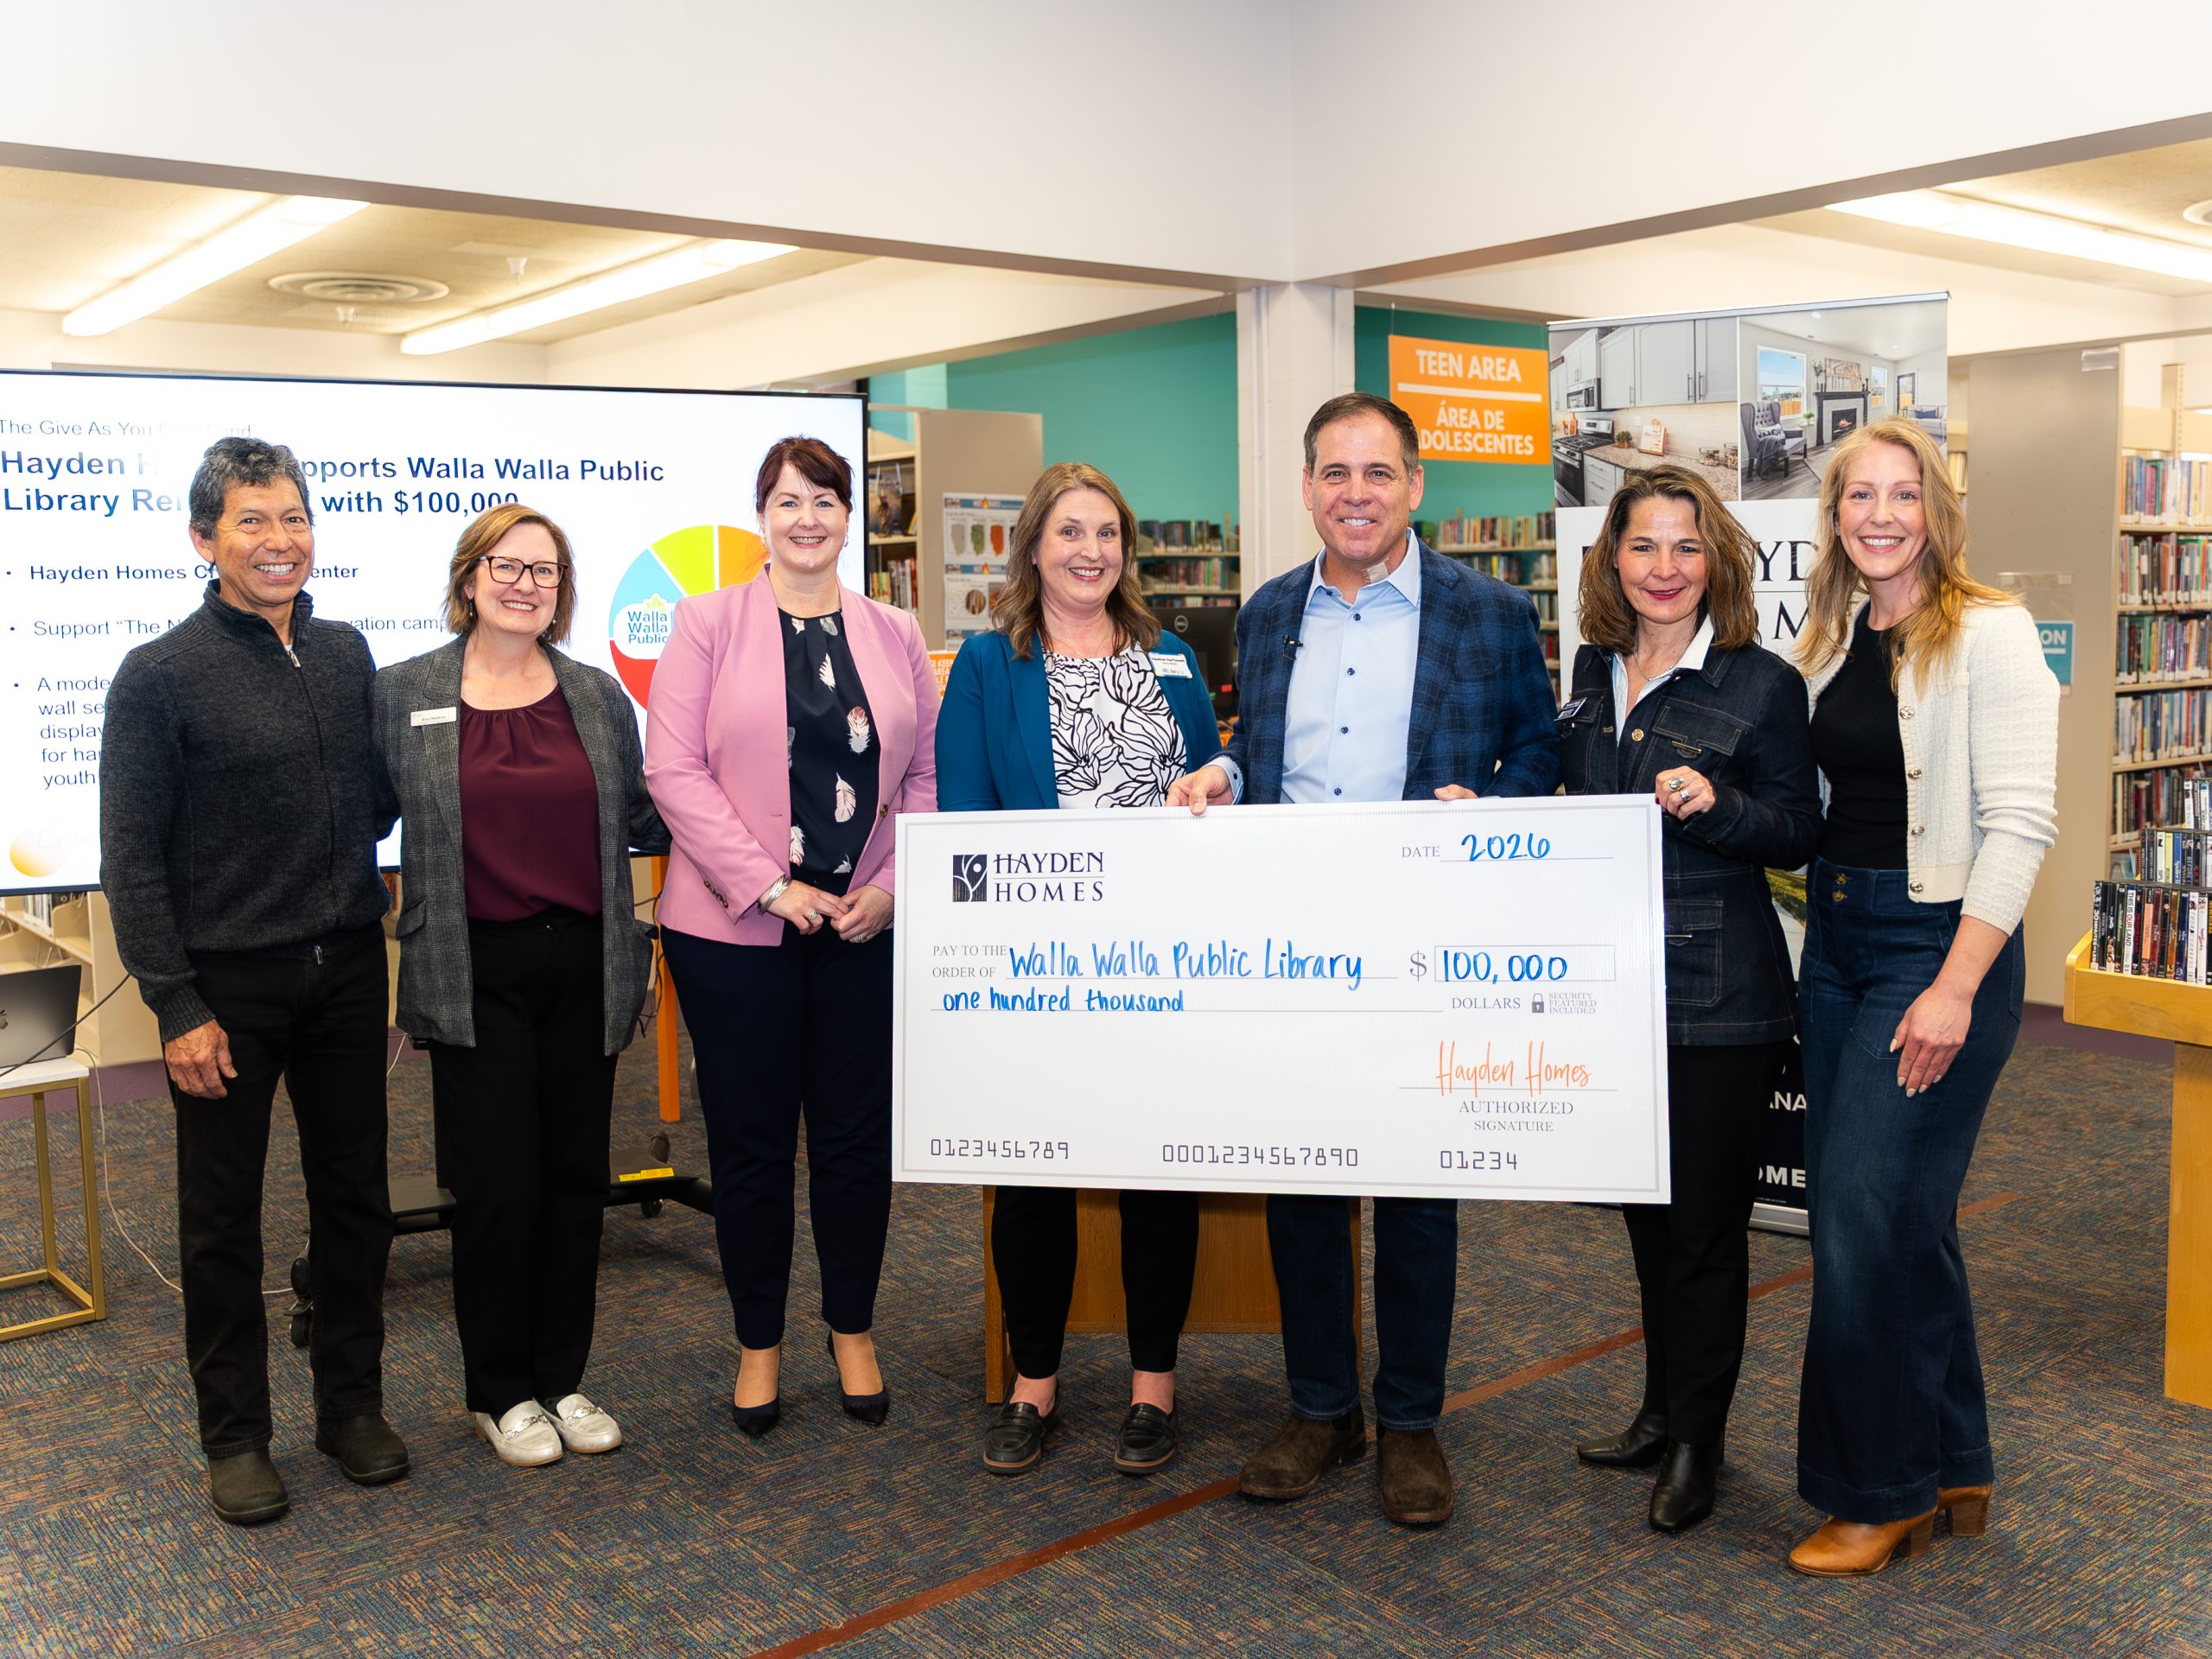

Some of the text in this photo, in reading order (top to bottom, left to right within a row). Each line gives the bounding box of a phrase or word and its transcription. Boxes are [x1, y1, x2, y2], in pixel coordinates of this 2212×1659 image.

[1415, 349, 1522, 383] TEEN AREA
[1436, 400, 1505, 430] ÁREA DE
[0, 420, 32, 434] The
[40, 420, 82, 435] Give
[88, 422, 111, 435] As
[118, 422, 152, 436] You
[1419, 429, 1534, 455] DOLESCENTES
[2, 450, 125, 480] Hayden
[301, 457, 397, 482] pports
[407, 457, 485, 478] Walla
[494, 459, 570, 480] Walla
[581, 460, 664, 480] Public
[3, 488, 120, 518] Library
[321, 490, 383, 512] with
[30, 565, 109, 584] Hayden
[117, 565, 188, 580] Homes
[311, 565, 359, 578] enter
[627, 610, 668, 622] Walla
[34, 619, 111, 639] Support
[402, 619, 448, 632] camp
[627, 621, 668, 633] Walla
[37, 677, 52, 692] A
[38, 700, 76, 715] wall
[41, 748, 67, 763] for
[43, 770, 96, 790] youth
[1402, 846, 1440, 858] DATE
[1461, 832, 1550, 861] 2026
[993, 851, 1104, 874] HAYDEN
[995, 881, 1103, 903] HOMES
[933, 944, 1007, 957] PAY TO THE
[932, 966, 995, 978] ORDER OF
[1009, 938, 1363, 991] Walla Walla Public Library
[1409, 950, 1427, 982] $
[1444, 950, 1568, 985] 100,000
[943, 985, 1185, 1012] one hundred thousand
[1452, 997, 1521, 1010] DOLLARS
[1435, 1039, 1592, 1097] Hayden Homes
[1459, 1100, 1573, 1115] AUTHORIZED
[1473, 1120, 1554, 1133] SIGNATURE
[930, 1139, 1070, 1160] 0123456789
[1162, 1144, 1358, 1167] 0001234567890
[1440, 1150, 1518, 1171] 01234
